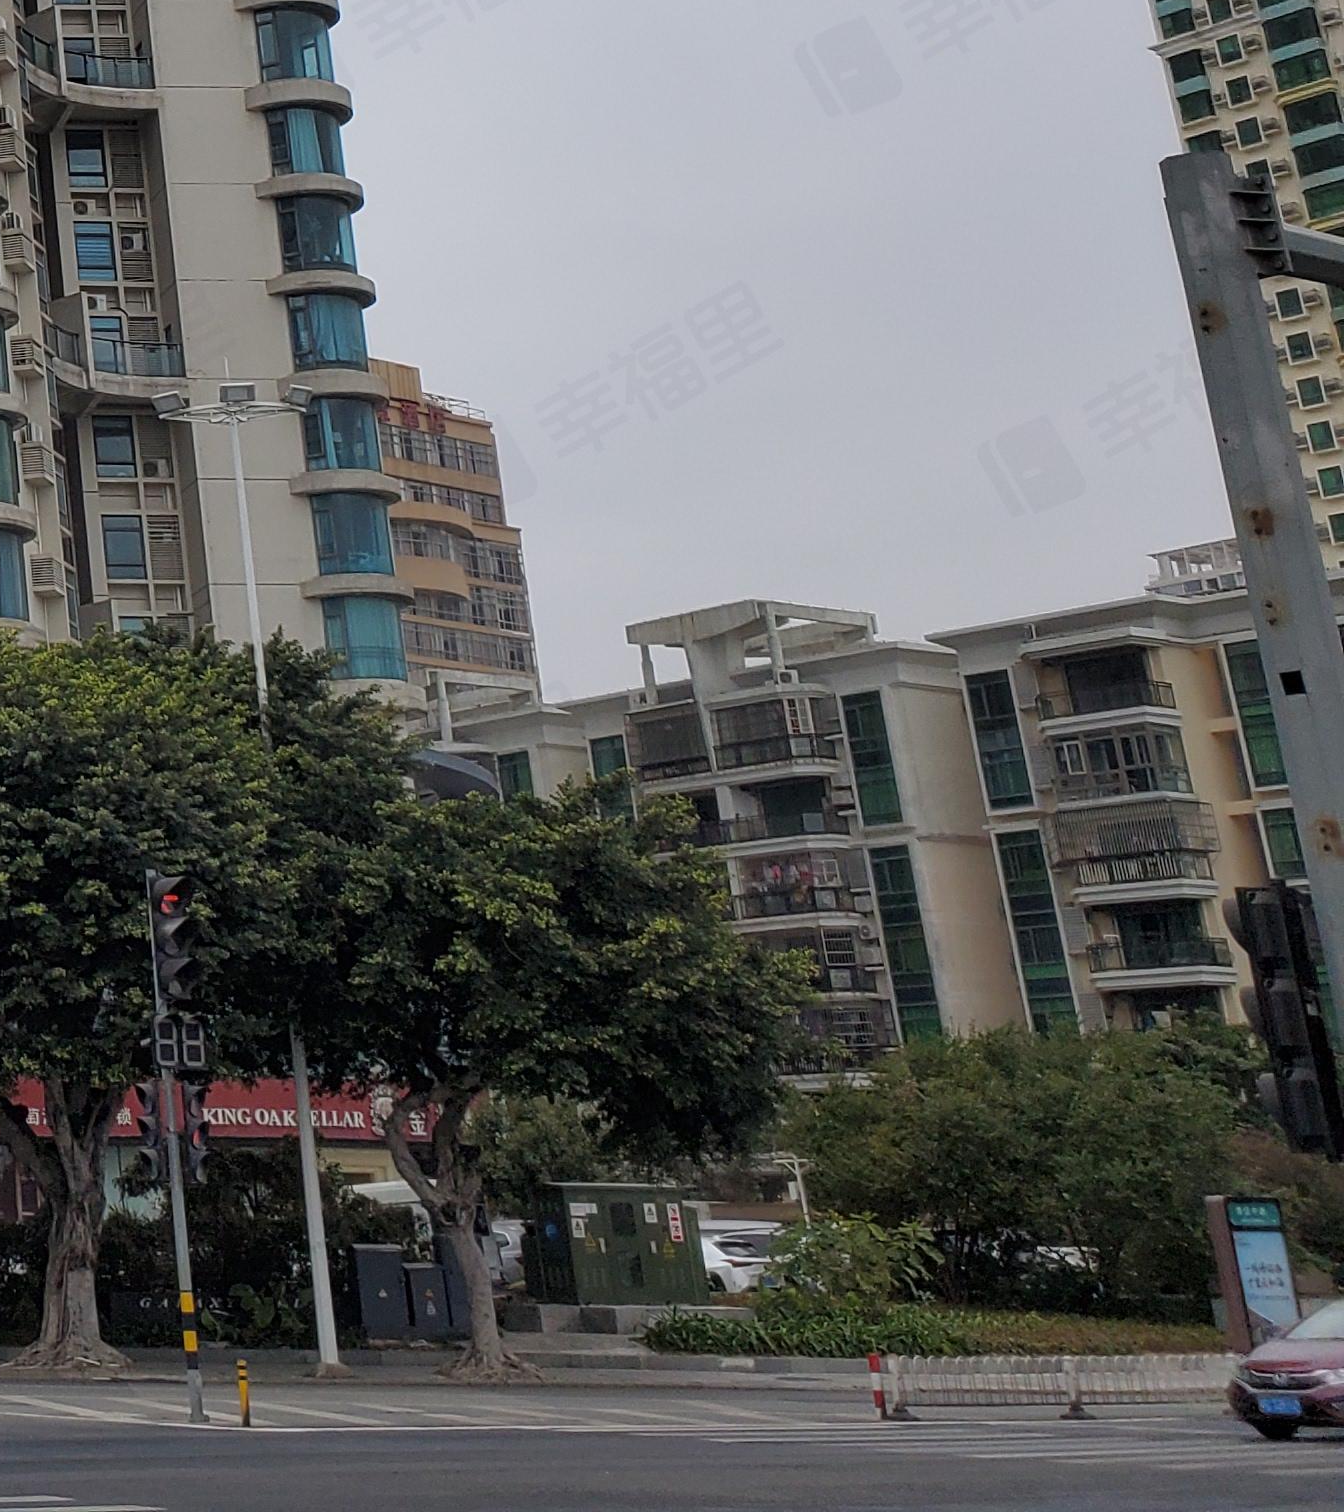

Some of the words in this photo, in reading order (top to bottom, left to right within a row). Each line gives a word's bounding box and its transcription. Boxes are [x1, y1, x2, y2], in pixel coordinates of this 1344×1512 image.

[201, 1108, 251, 1125] KING
[254, 1108, 297, 1127] OAK
[311, 1110, 366, 1129] ELLAR
